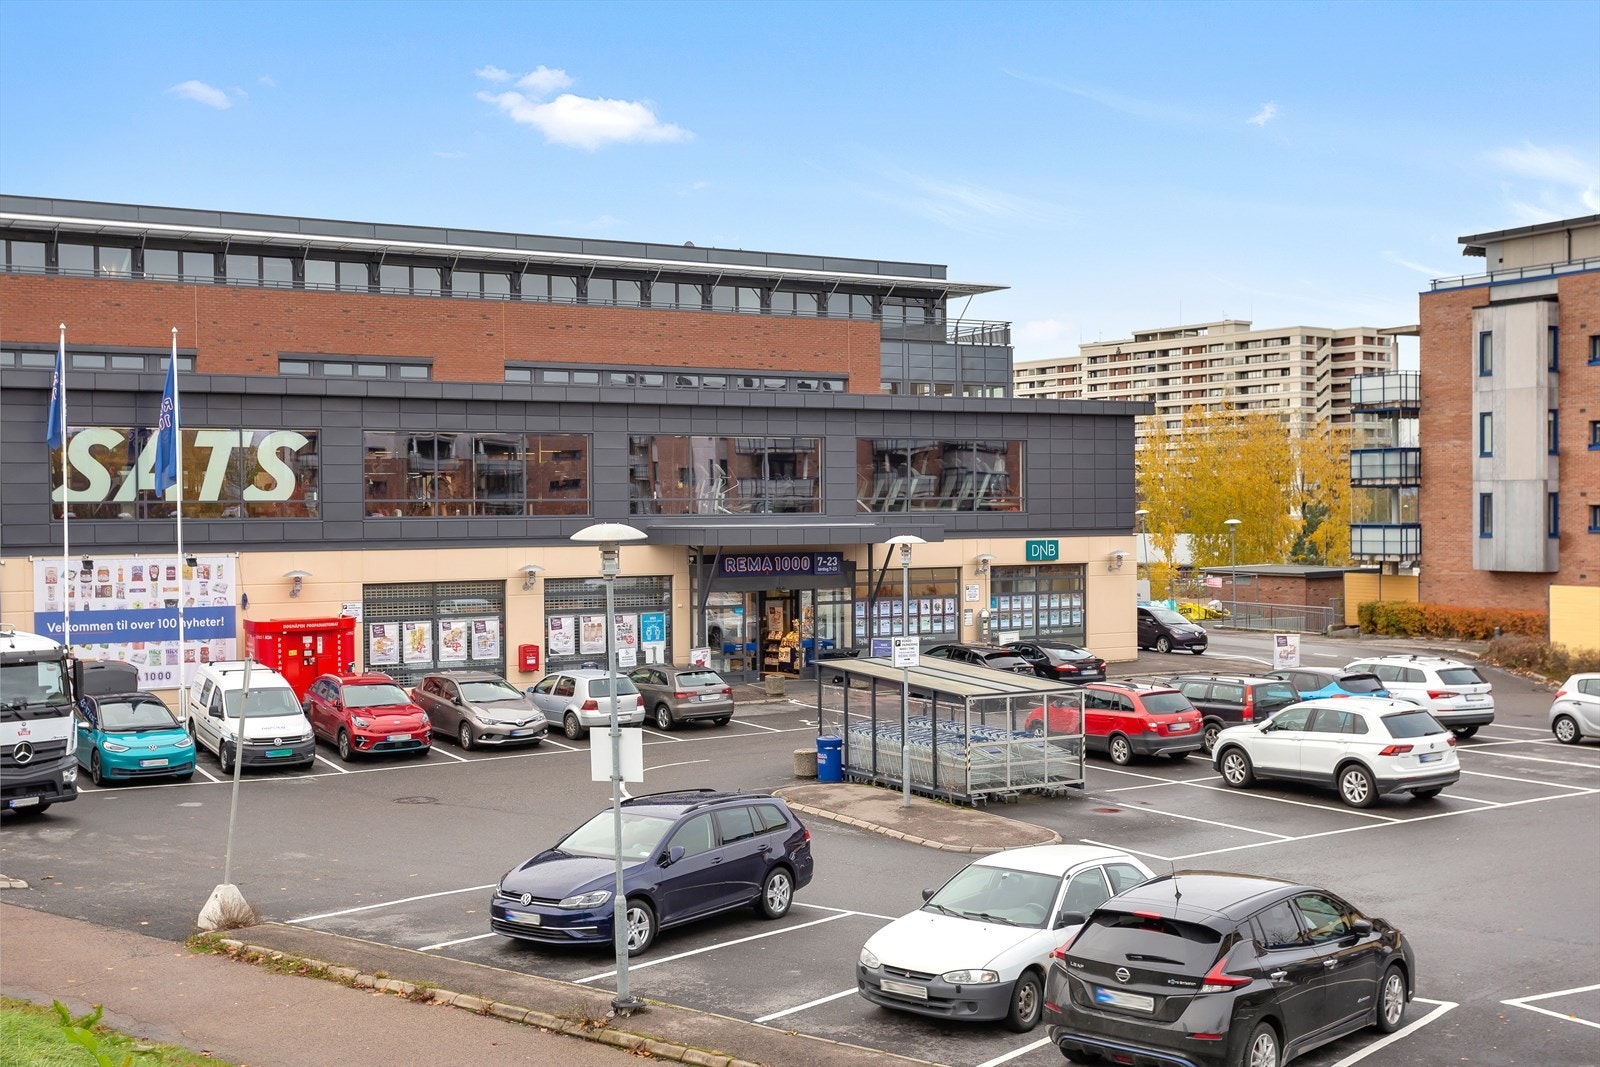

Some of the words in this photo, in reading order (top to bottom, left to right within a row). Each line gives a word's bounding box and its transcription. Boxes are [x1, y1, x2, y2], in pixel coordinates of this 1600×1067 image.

[51, 428, 310, 502] SATS
[1031, 540, 1056, 560] DNB
[724, 556, 773, 573] REMA
[774, 556, 811, 571] 1000
[817, 556, 838, 567] 7-23
[47, 619, 114, 634] Velkommen
[116, 619, 128, 630] til
[130, 620, 155, 630] over
[157, 618, 177, 629] 100
[145, 671, 172, 681] 1000
